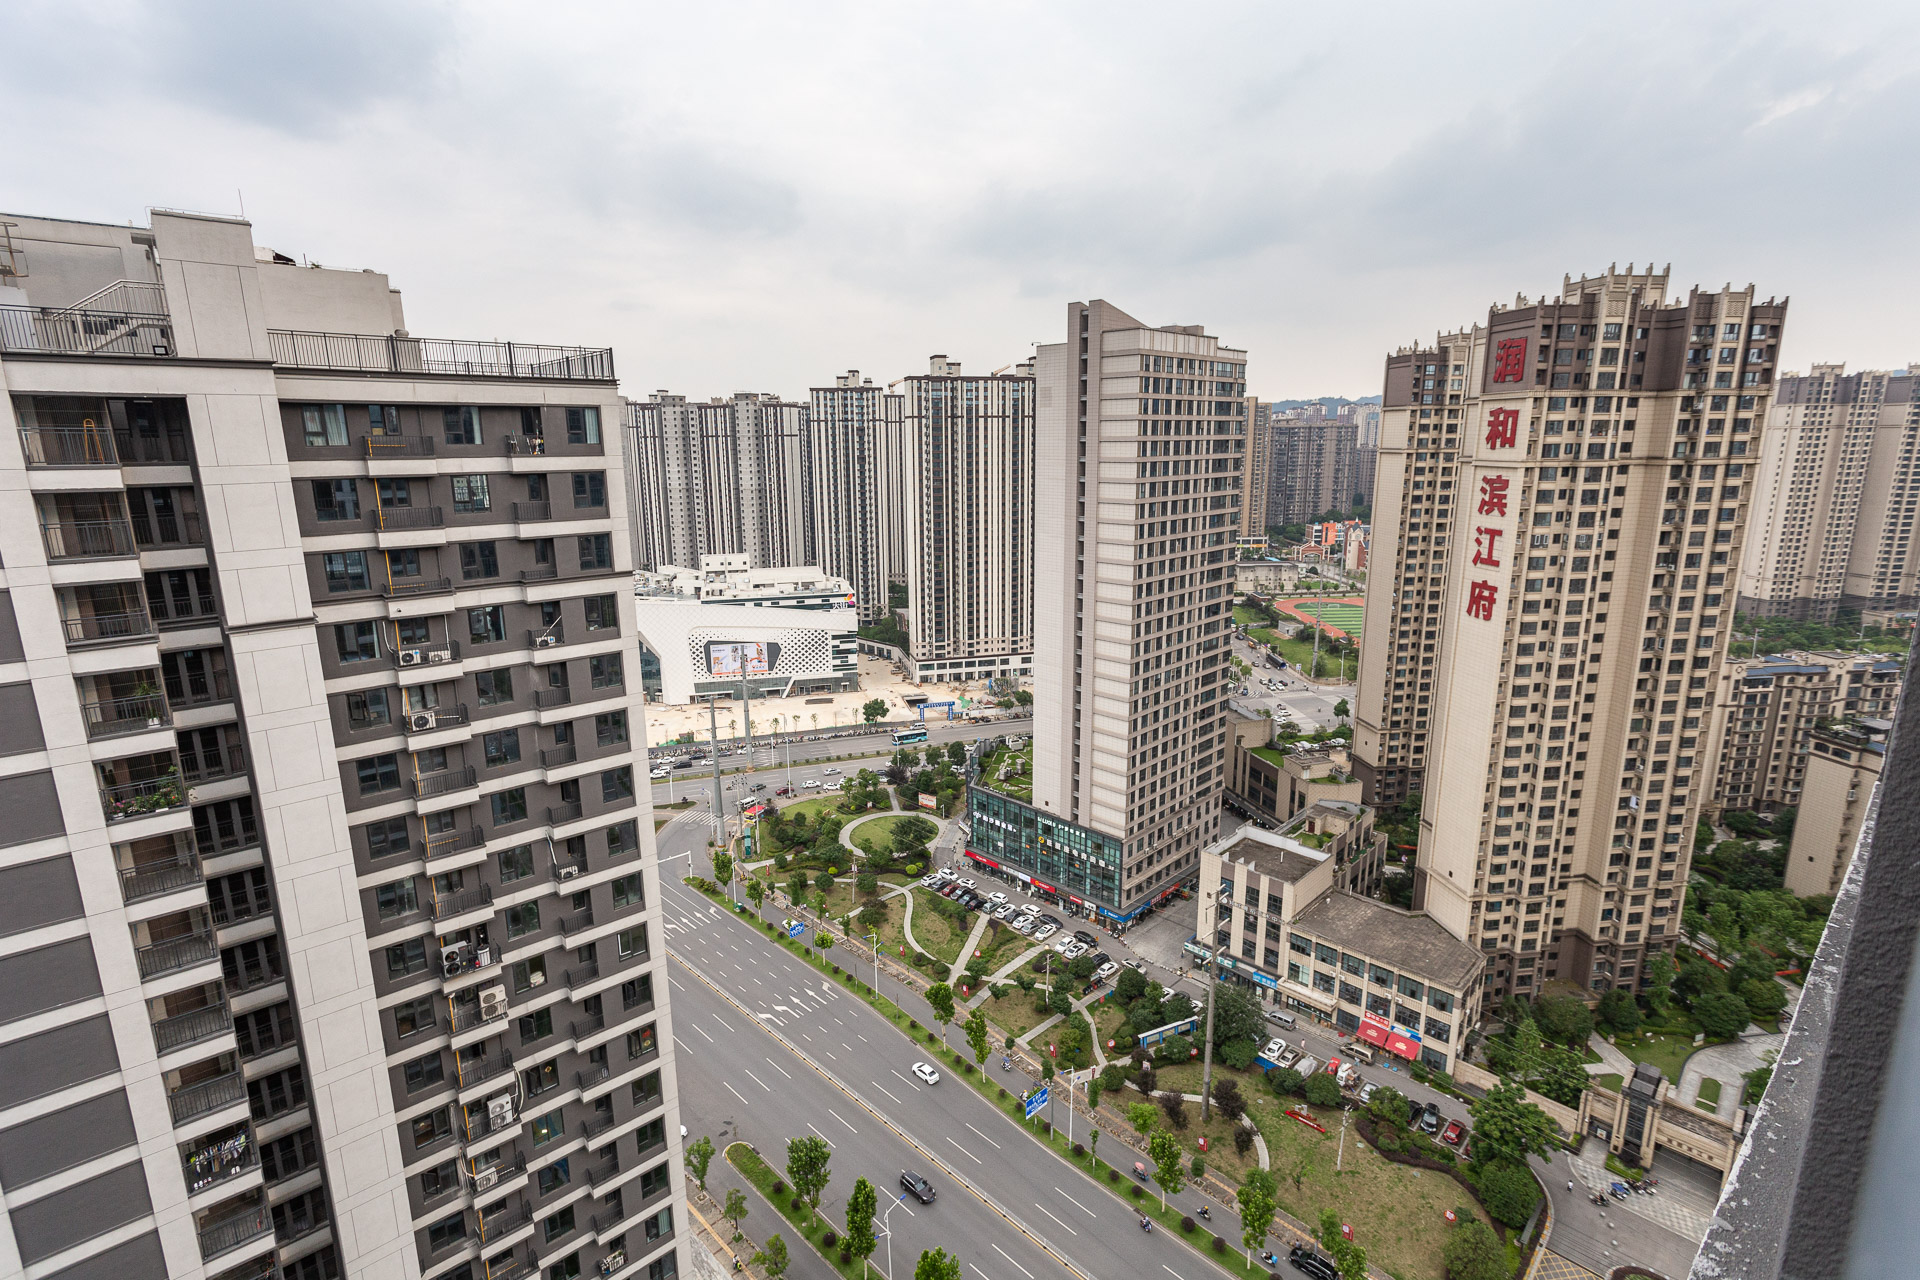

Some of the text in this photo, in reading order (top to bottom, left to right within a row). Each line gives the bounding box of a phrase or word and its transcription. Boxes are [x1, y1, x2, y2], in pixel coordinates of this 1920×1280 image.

[1466, 336, 1528, 622] 润和滨江府
